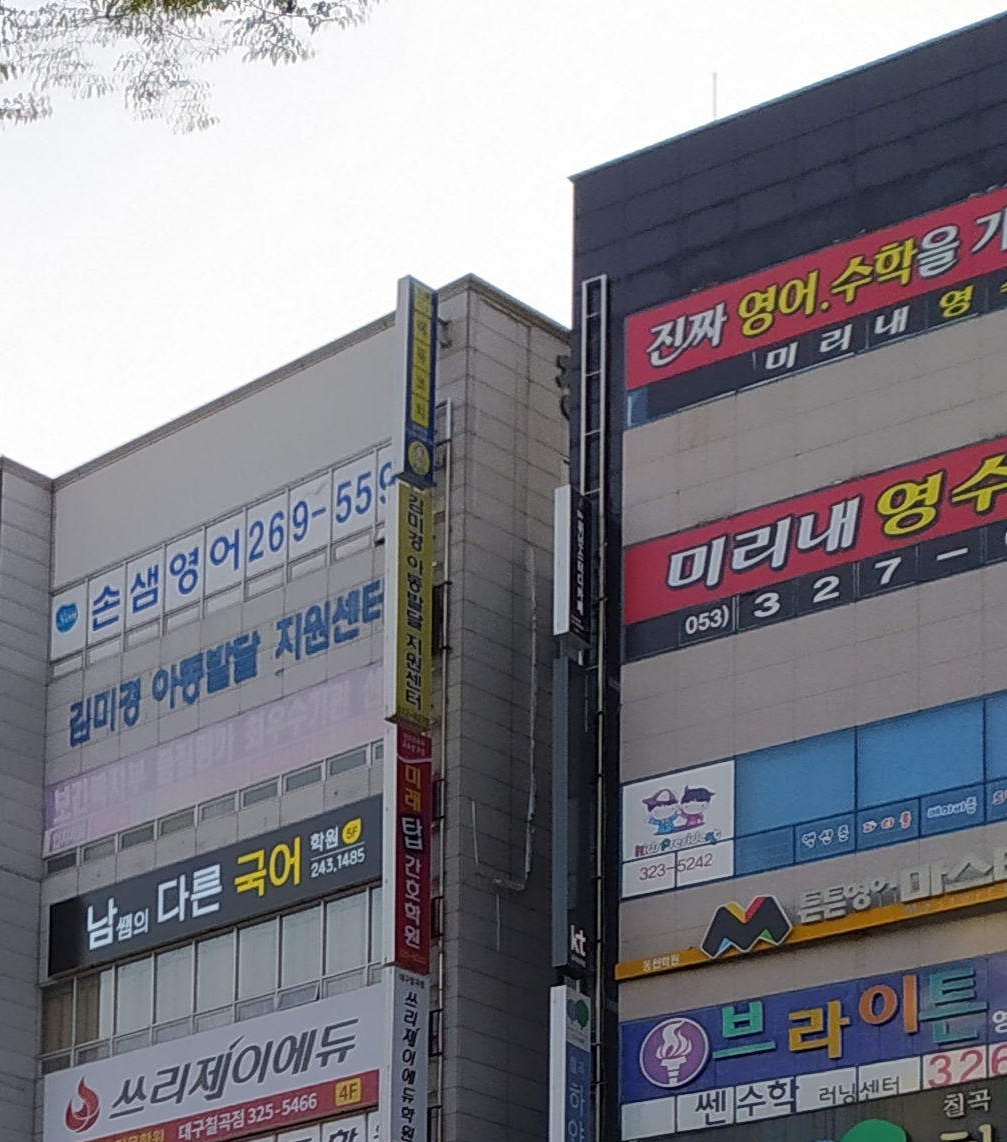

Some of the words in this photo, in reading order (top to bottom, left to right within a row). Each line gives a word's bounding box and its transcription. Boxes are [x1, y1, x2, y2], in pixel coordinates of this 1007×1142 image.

[647, 302, 728, 367] 진짜
[765, 306, 910, 371] 미리내
[666, 496, 862, 589] 미리내
[92, 529, 241, 632] 손샘영어
[685, 601, 730, 635] 053)
[70, 678, 141, 747] 김미경
[405, 765, 422, 812] 미래
[310, 826, 338, 852] 학원
[310, 850, 366, 879] 243.1485
[402, 816, 424, 851] 탑
[157, 863, 222, 924] 다른
[234, 837, 302, 897] 국어
[639, 853, 713, 880] 323-5242
[405, 853, 422, 950] 간호학원
[571, 925, 586, 957] kt
[713, 968, 987, 1059] 브라이튼
[109, 1016, 359, 1121] 쓰리제이에듀
[401, 991, 420, 1142] 쓰리제이에듀학원
[178, 1110, 247, 1141] 대구칠곡점
[248, 1093, 318, 1125] 325-5466
[339, 1081, 358, 1101] 4F
[696, 1076, 799, 1125] 쎈수학
[818, 1076, 900, 1105] 러닝센터
[943, 1089, 992, 1118] 칠곡
